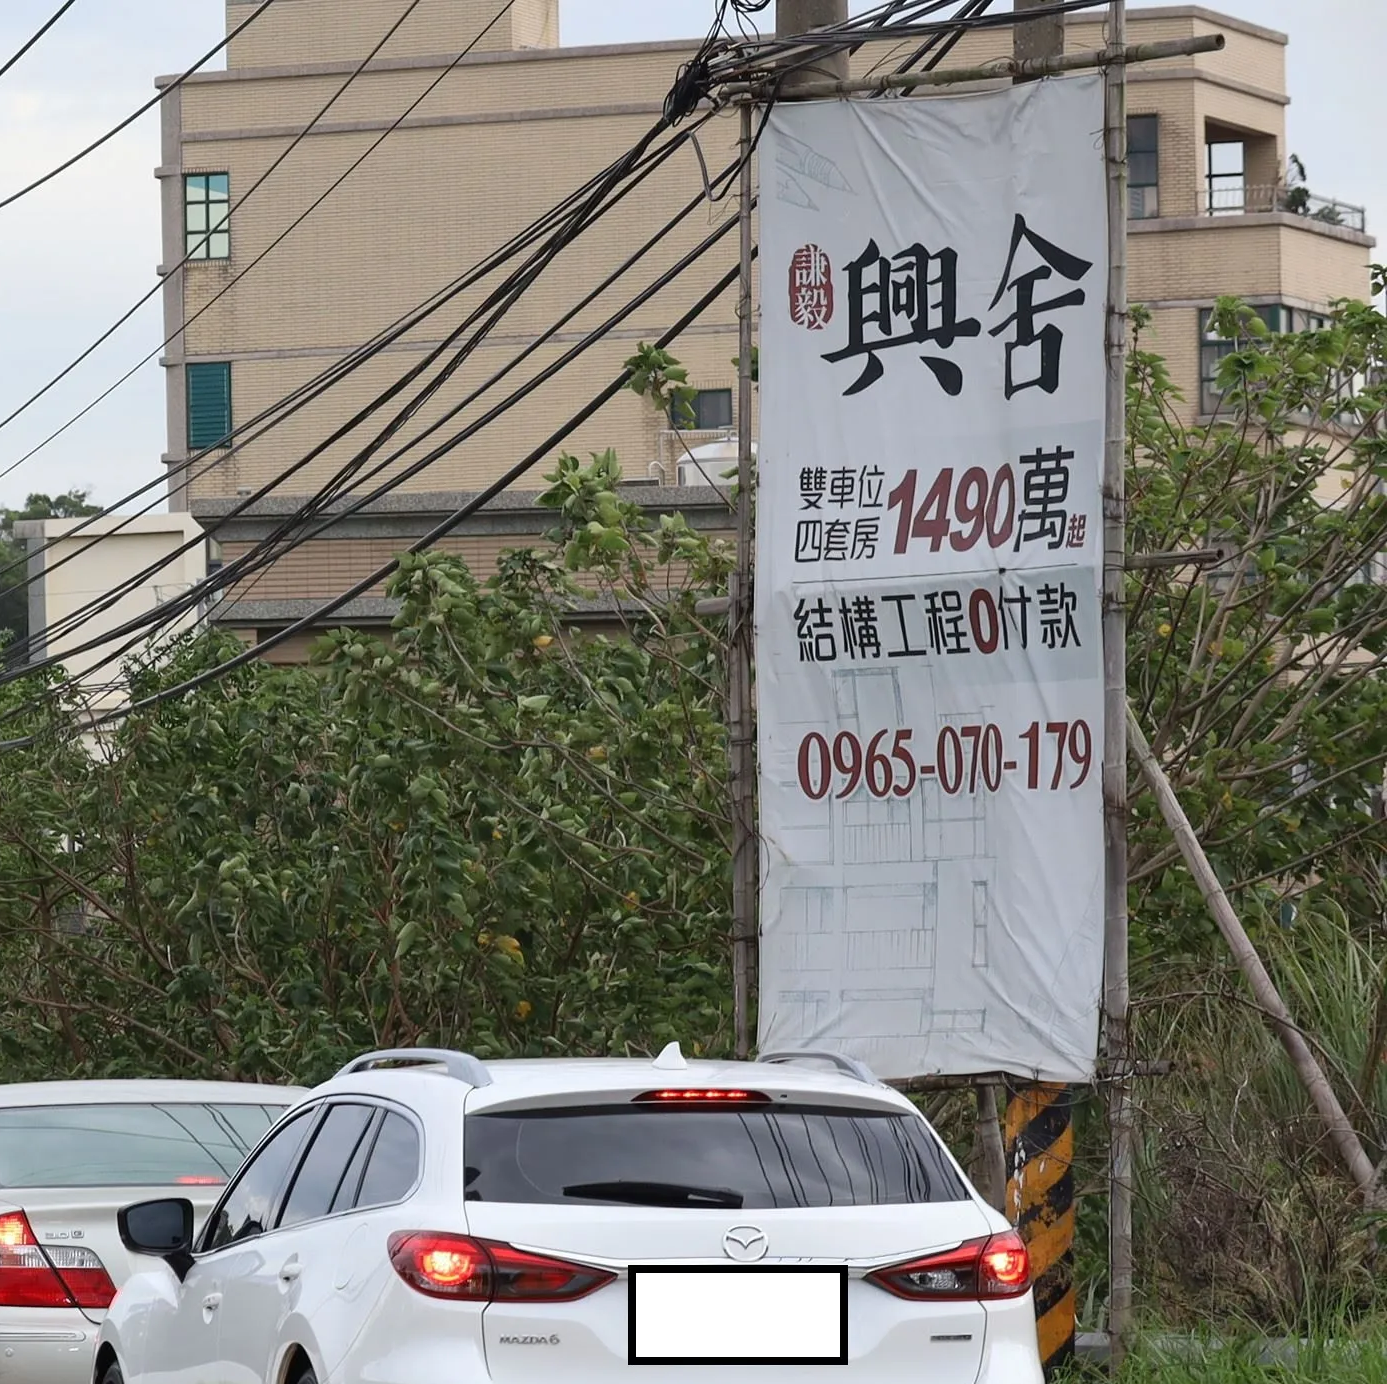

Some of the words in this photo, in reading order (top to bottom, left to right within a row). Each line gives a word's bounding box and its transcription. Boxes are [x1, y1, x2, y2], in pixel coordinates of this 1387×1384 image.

[798, 465, 886, 511] 雙車位
[794, 517, 880, 563] 四套房
[797, 718, 1093, 801] 0965-070-179
